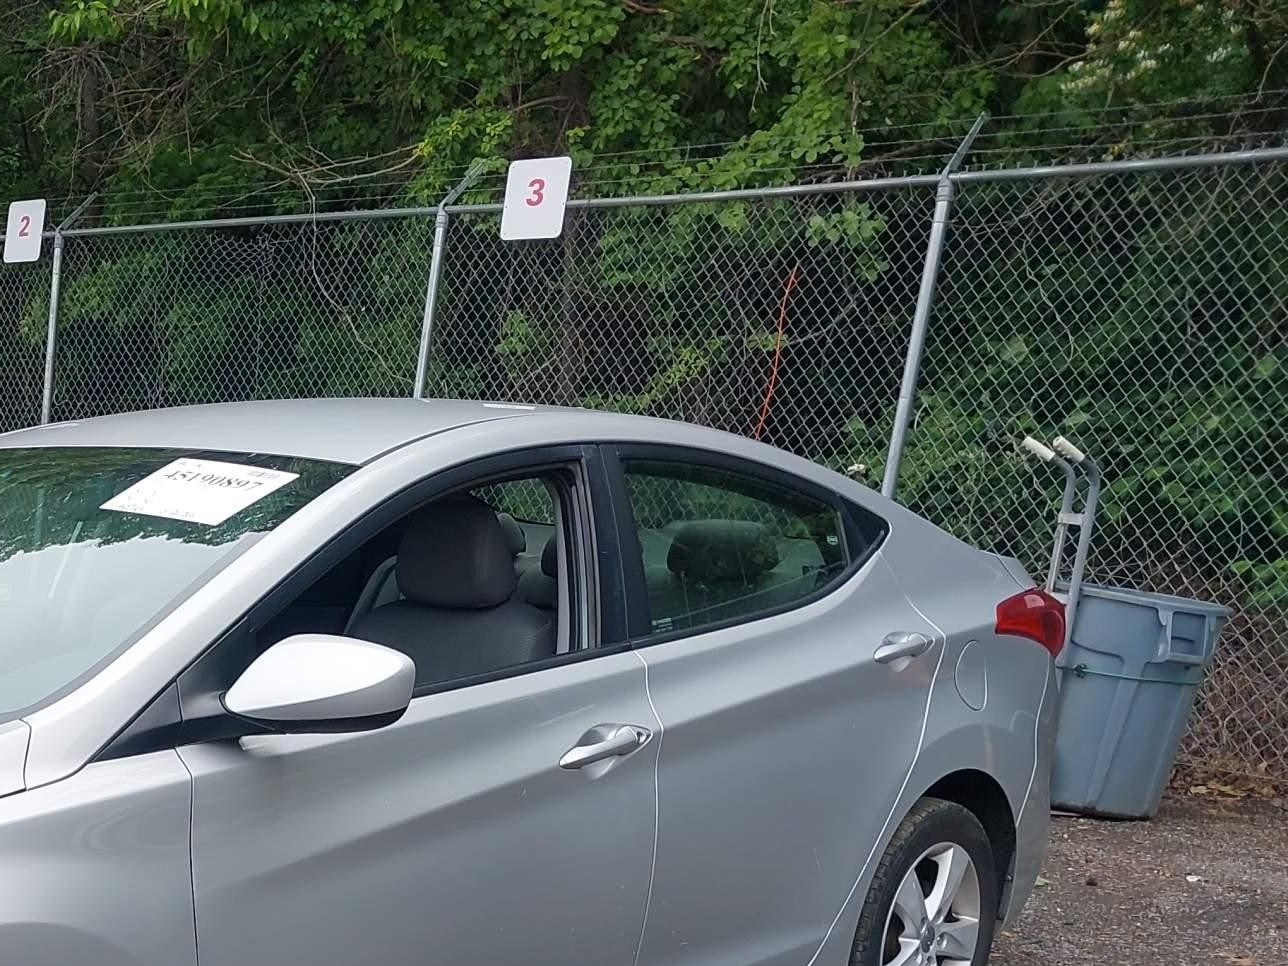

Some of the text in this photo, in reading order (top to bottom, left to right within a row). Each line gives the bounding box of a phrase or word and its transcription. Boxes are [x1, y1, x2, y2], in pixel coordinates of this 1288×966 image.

[525, 178, 546, 206] 3
[18, 215, 31, 237] 2
[164, 469, 264, 491] 45190897
